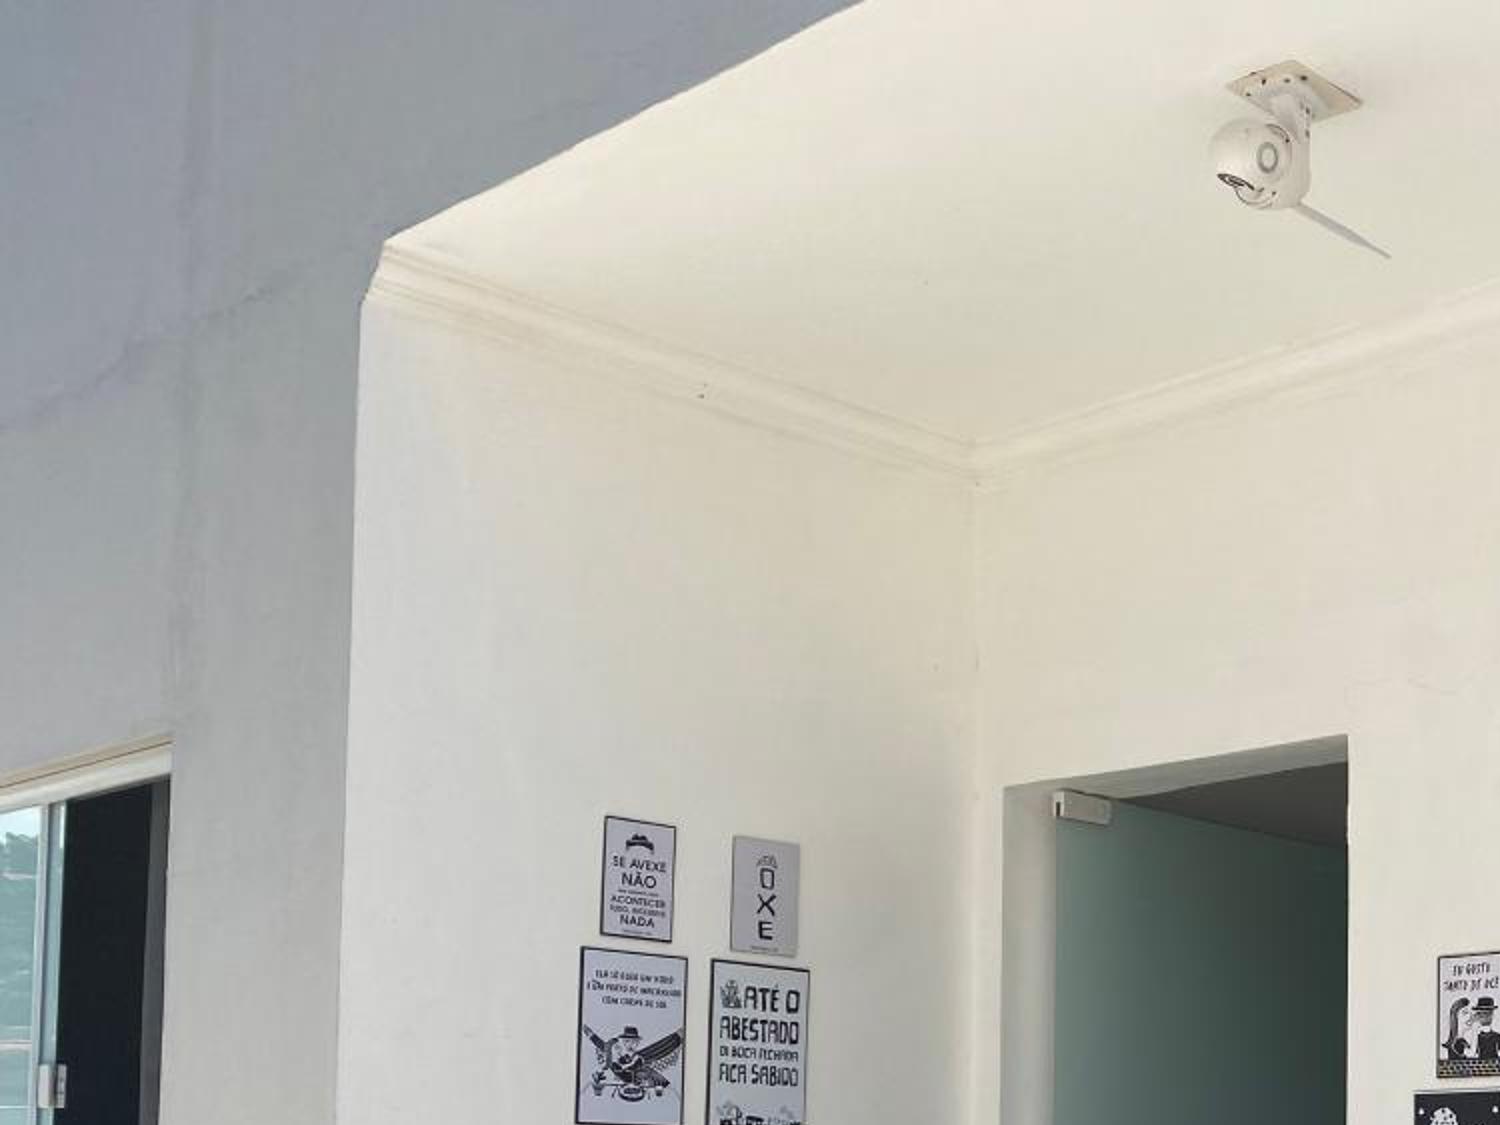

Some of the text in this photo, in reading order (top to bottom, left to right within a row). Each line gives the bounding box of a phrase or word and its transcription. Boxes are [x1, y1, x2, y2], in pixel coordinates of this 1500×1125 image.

[630, 859, 666, 873] AVEXE
[621, 872, 656, 889] NÃO
[620, 914, 655, 928] NADA
[744, 983, 800, 1014] ATÉ O
[720, 1016, 799, 1045] ABESTADO
[731, 1046, 757, 1059] BOCA
[751, 1064, 799, 1087] SABIDO
